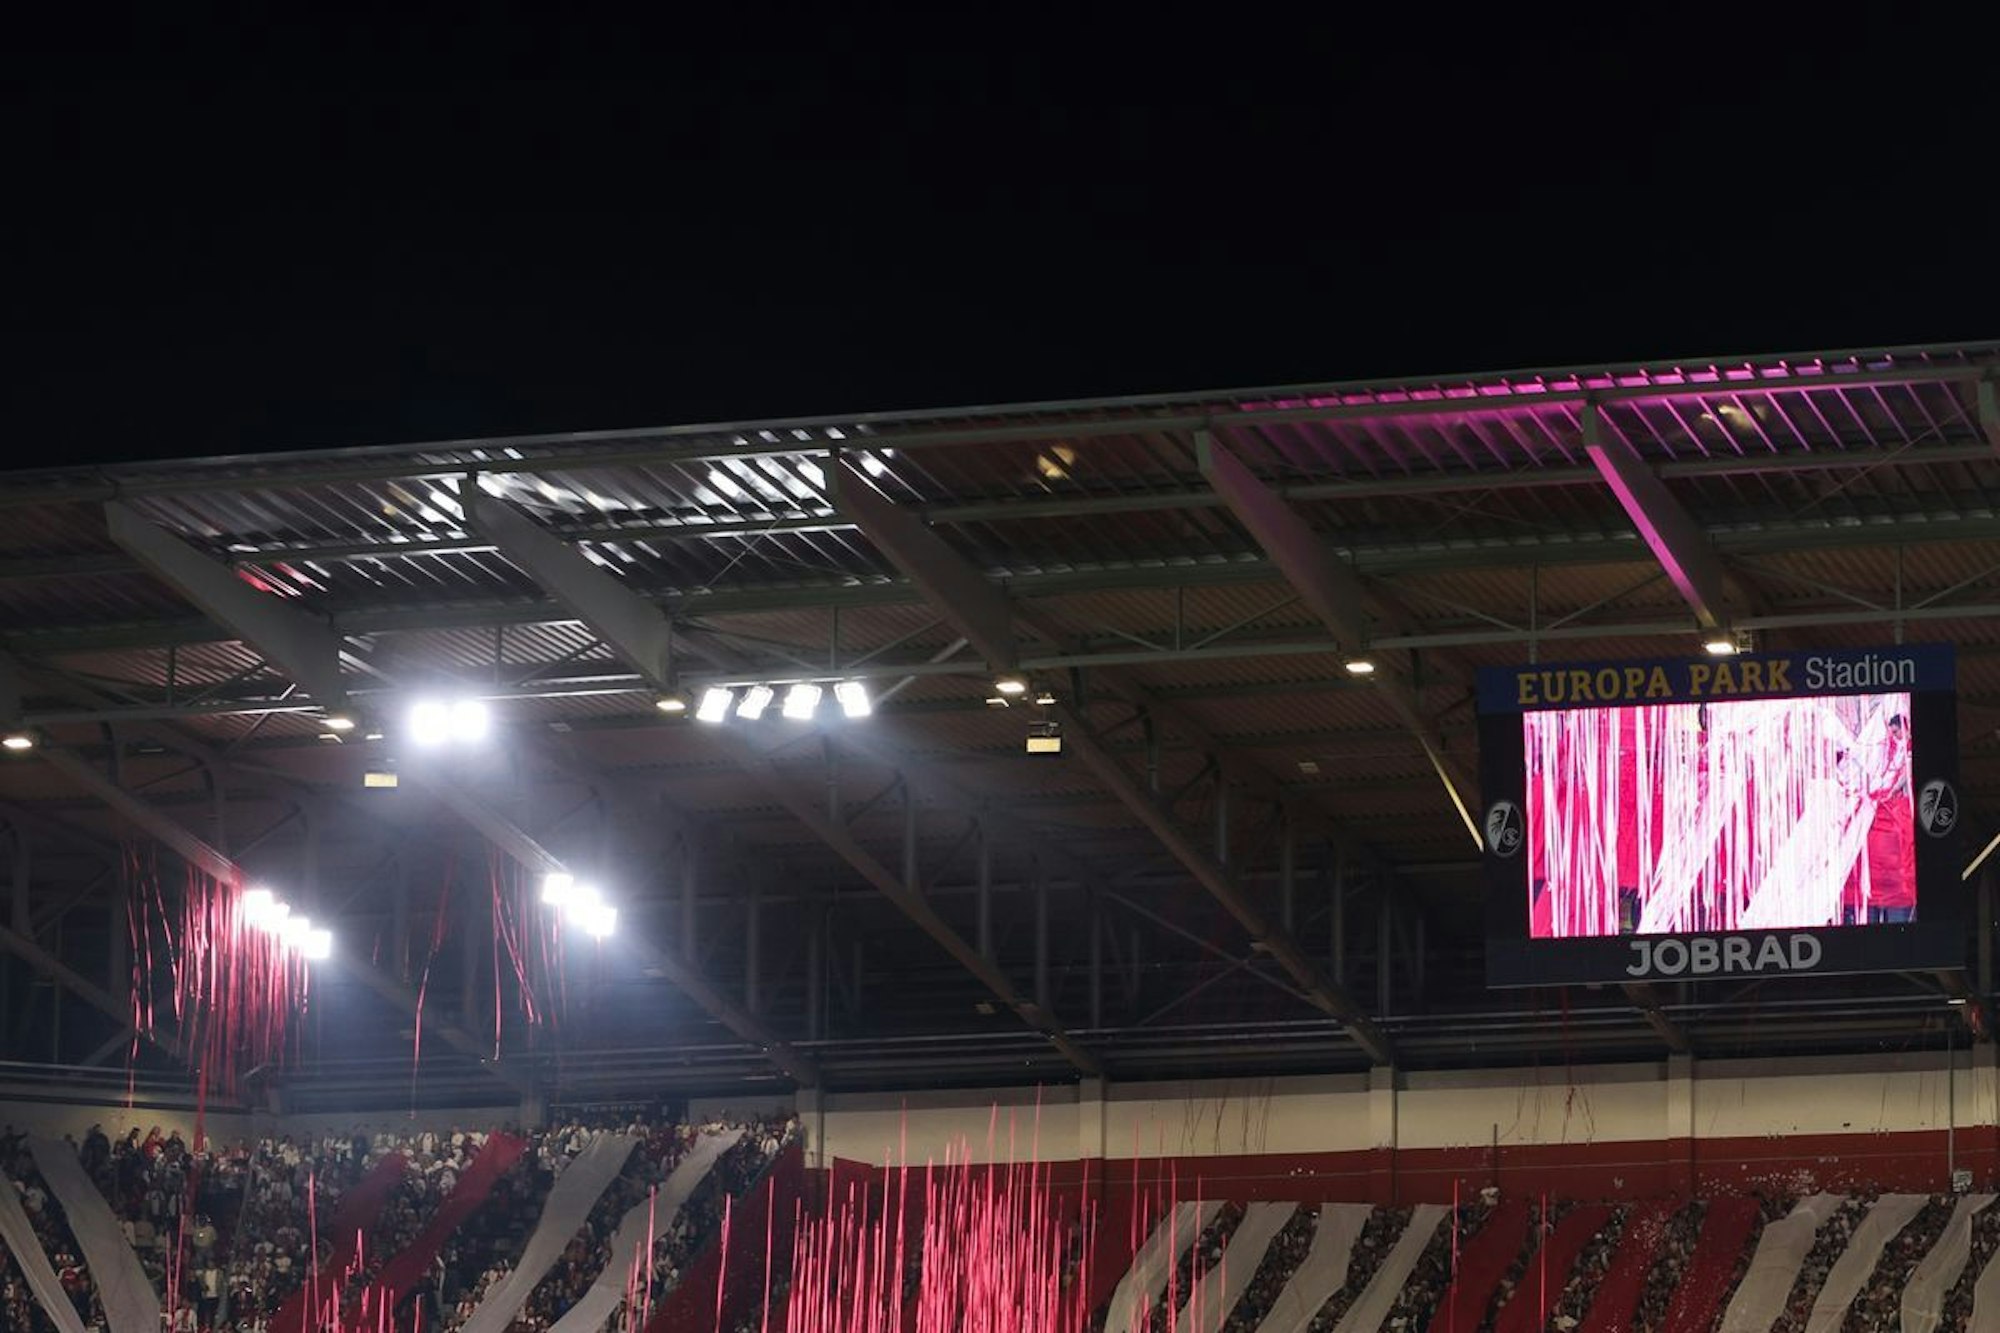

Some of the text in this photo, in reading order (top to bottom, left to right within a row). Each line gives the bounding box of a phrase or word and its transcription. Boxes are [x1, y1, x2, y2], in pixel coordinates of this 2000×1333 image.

[1518, 655, 1915, 704] EUROPA PARK Stadion
[1627, 935, 1822, 976] JOBRAD
